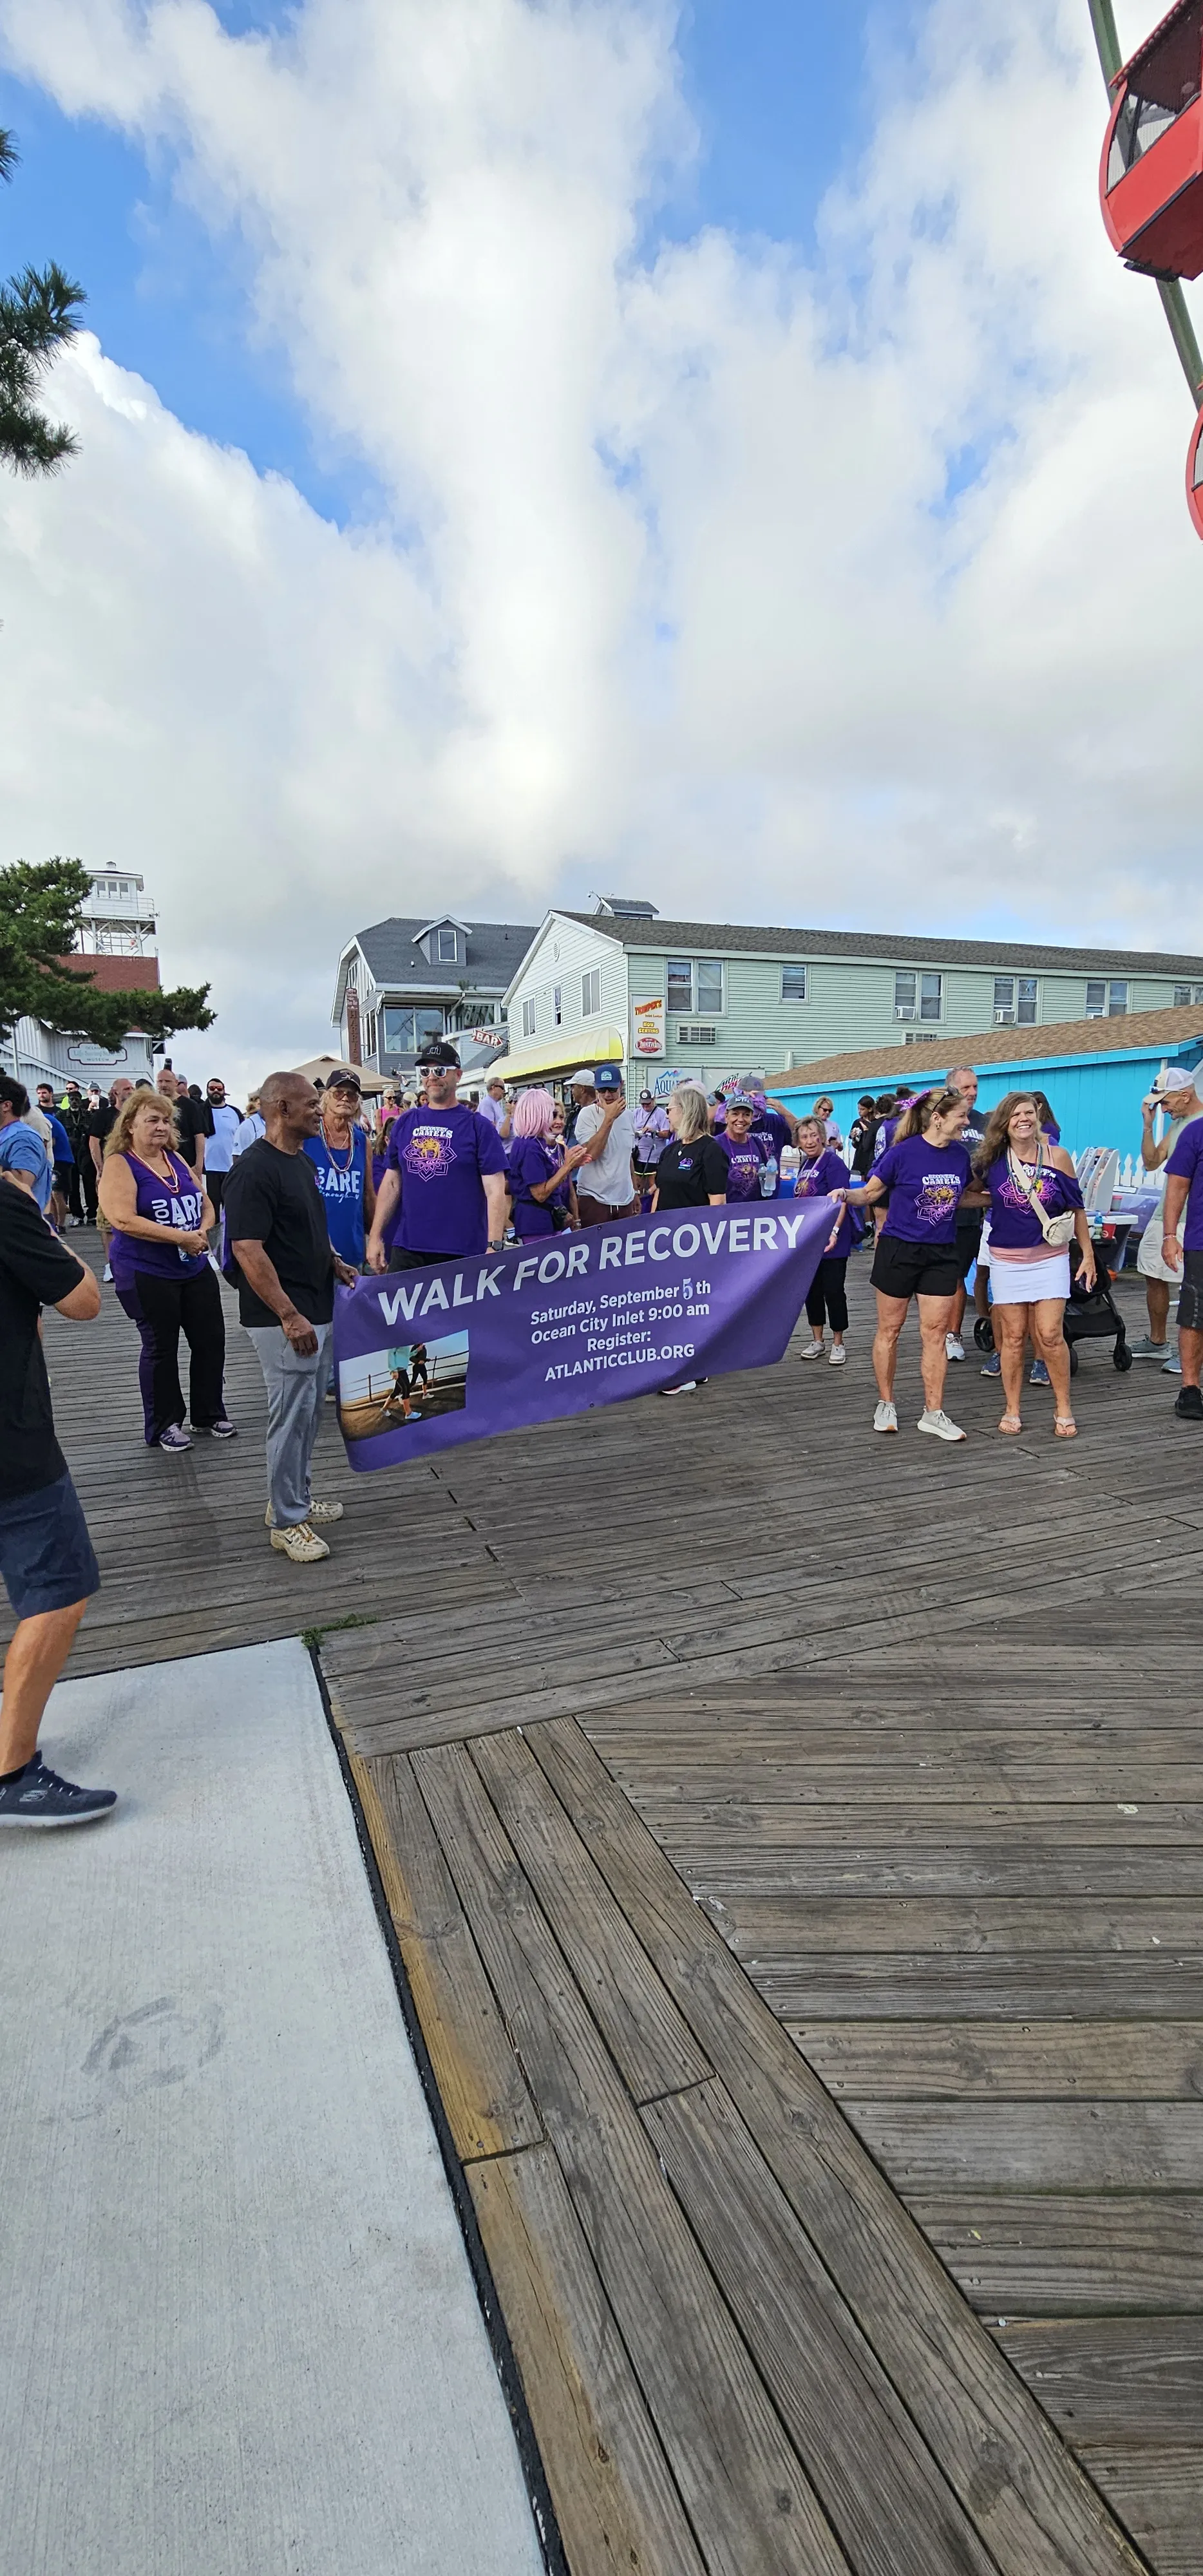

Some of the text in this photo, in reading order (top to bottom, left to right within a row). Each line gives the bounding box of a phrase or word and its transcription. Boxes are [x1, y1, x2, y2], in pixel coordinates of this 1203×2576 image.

[476, 1031, 498, 1046] BAR
[325, 1168, 361, 1193] ARE
[922, 1176, 961, 1186] CAMELS
[377, 1214, 805, 1326] WALK FOR RECOVERY
[530, 1300, 596, 1325] Saturday,
[600, 1286, 680, 1309] September
[696, 1280, 711, 1295] th
[531, 1303, 710, 1344] Ocean City Inlet 9:00 am
[587, 1330, 652, 1352] Register:
[544, 1343, 696, 1382] ATLANTICCLUB.ORG
